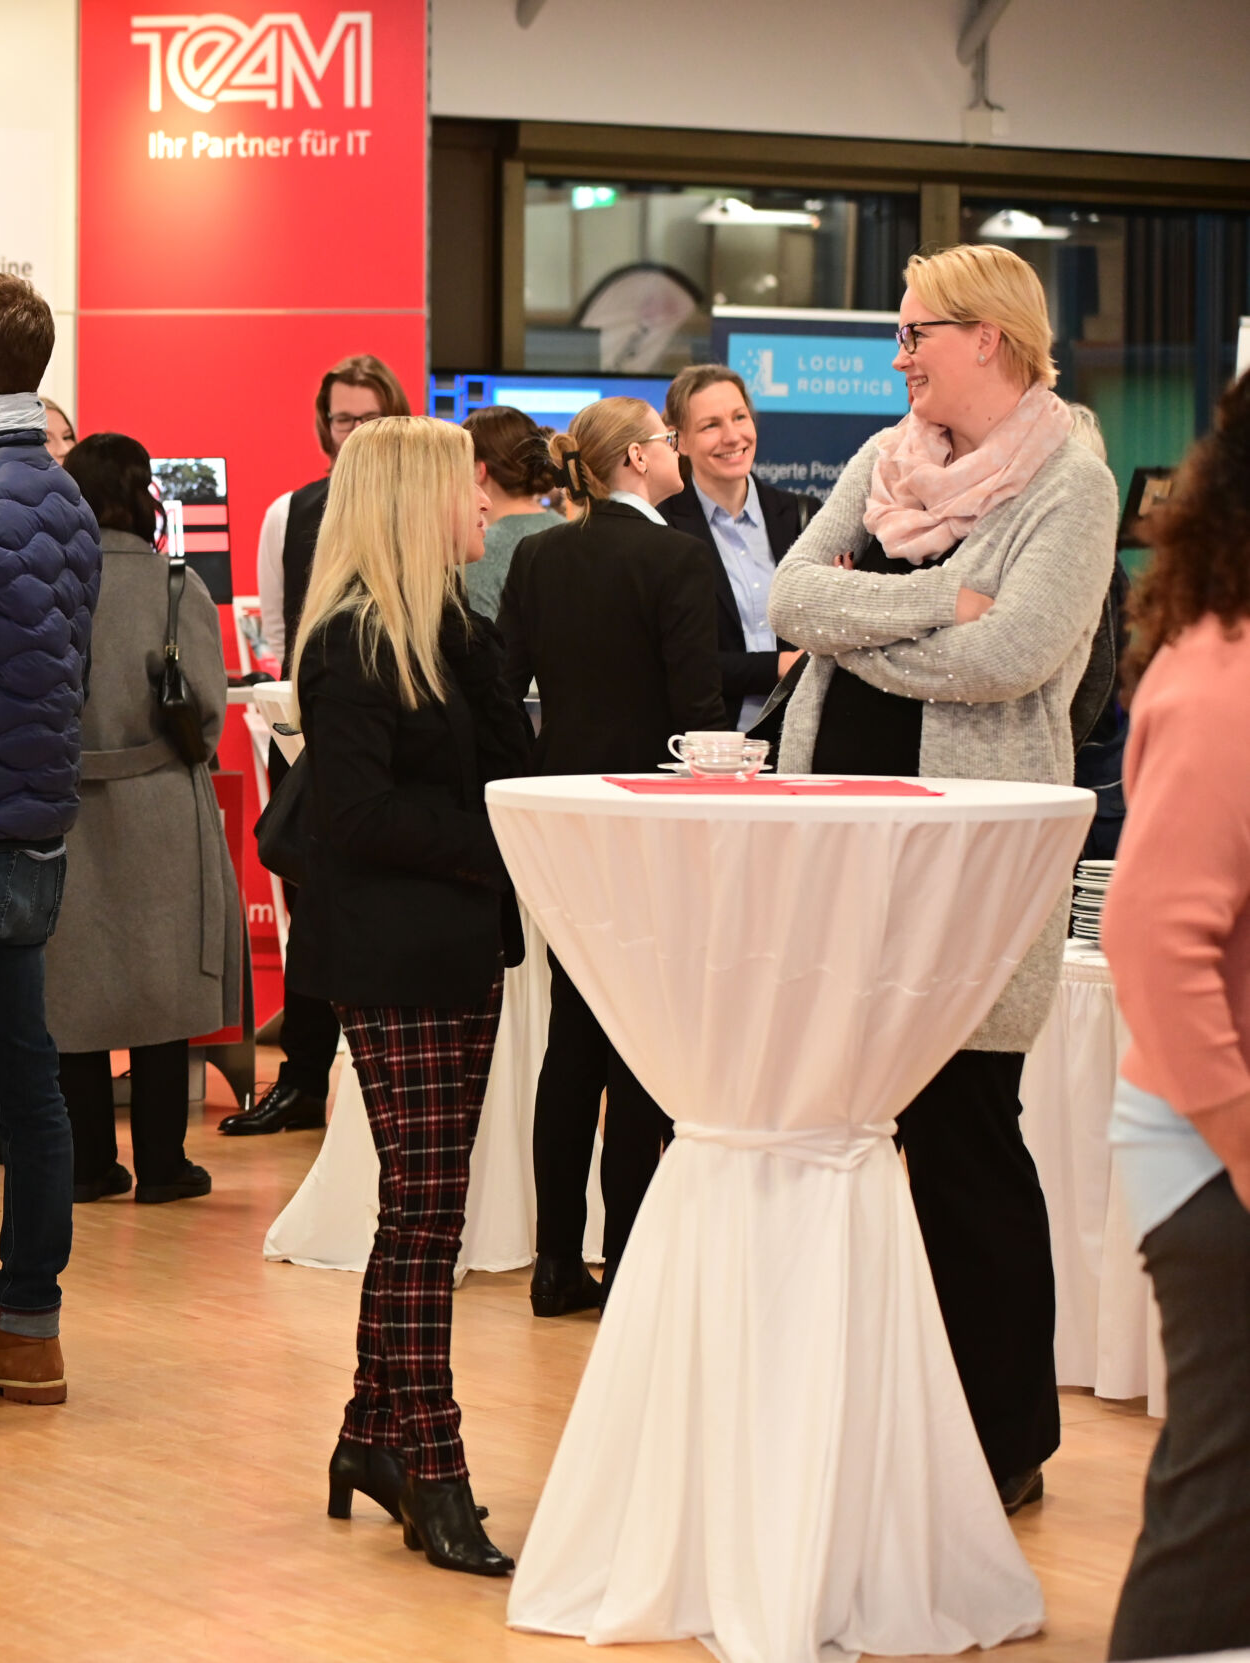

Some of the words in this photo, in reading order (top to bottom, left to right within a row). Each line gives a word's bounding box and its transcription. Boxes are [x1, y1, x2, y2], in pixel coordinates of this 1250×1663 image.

[148, 131, 187, 159] Ihr
[192, 130, 293, 158] Partner
[299, 129, 340, 156] für
[347, 130, 371, 156] IT
[799, 355, 865, 373] LOCUS
[798, 376, 894, 397] ROBOTICS
